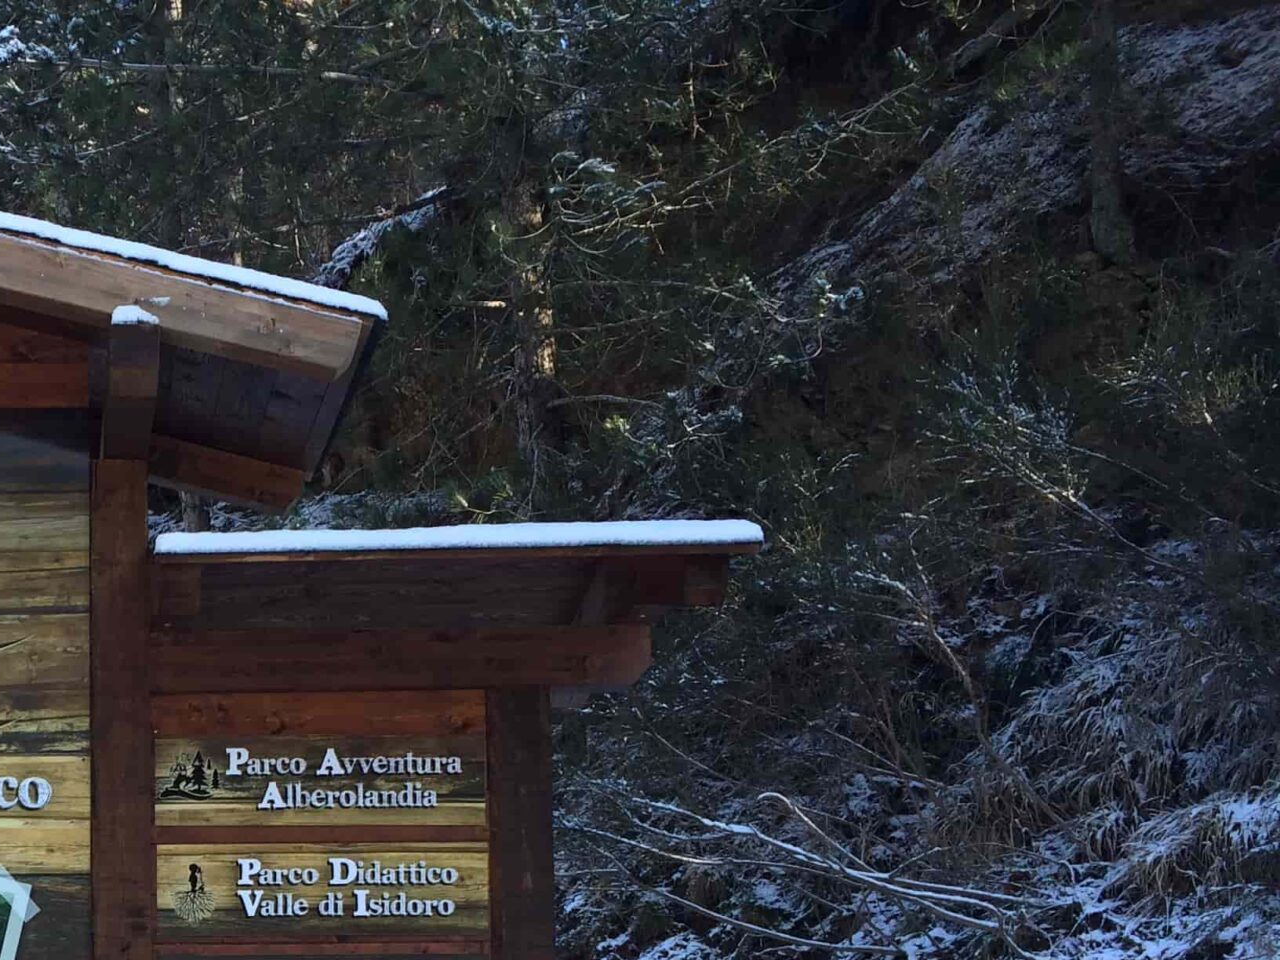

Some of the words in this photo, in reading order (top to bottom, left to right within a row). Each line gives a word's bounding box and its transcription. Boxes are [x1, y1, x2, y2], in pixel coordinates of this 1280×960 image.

[226, 748, 307, 776] Parco
[317, 748, 463, 776] Avventura
[258, 782, 439, 809] Alberolandia
[236, 858, 319, 886] Parco
[328, 857, 459, 886] Didattico
[237, 889, 308, 917] Valle
[318, 892, 344, 917] di
[353, 889, 455, 917] Isidoro
